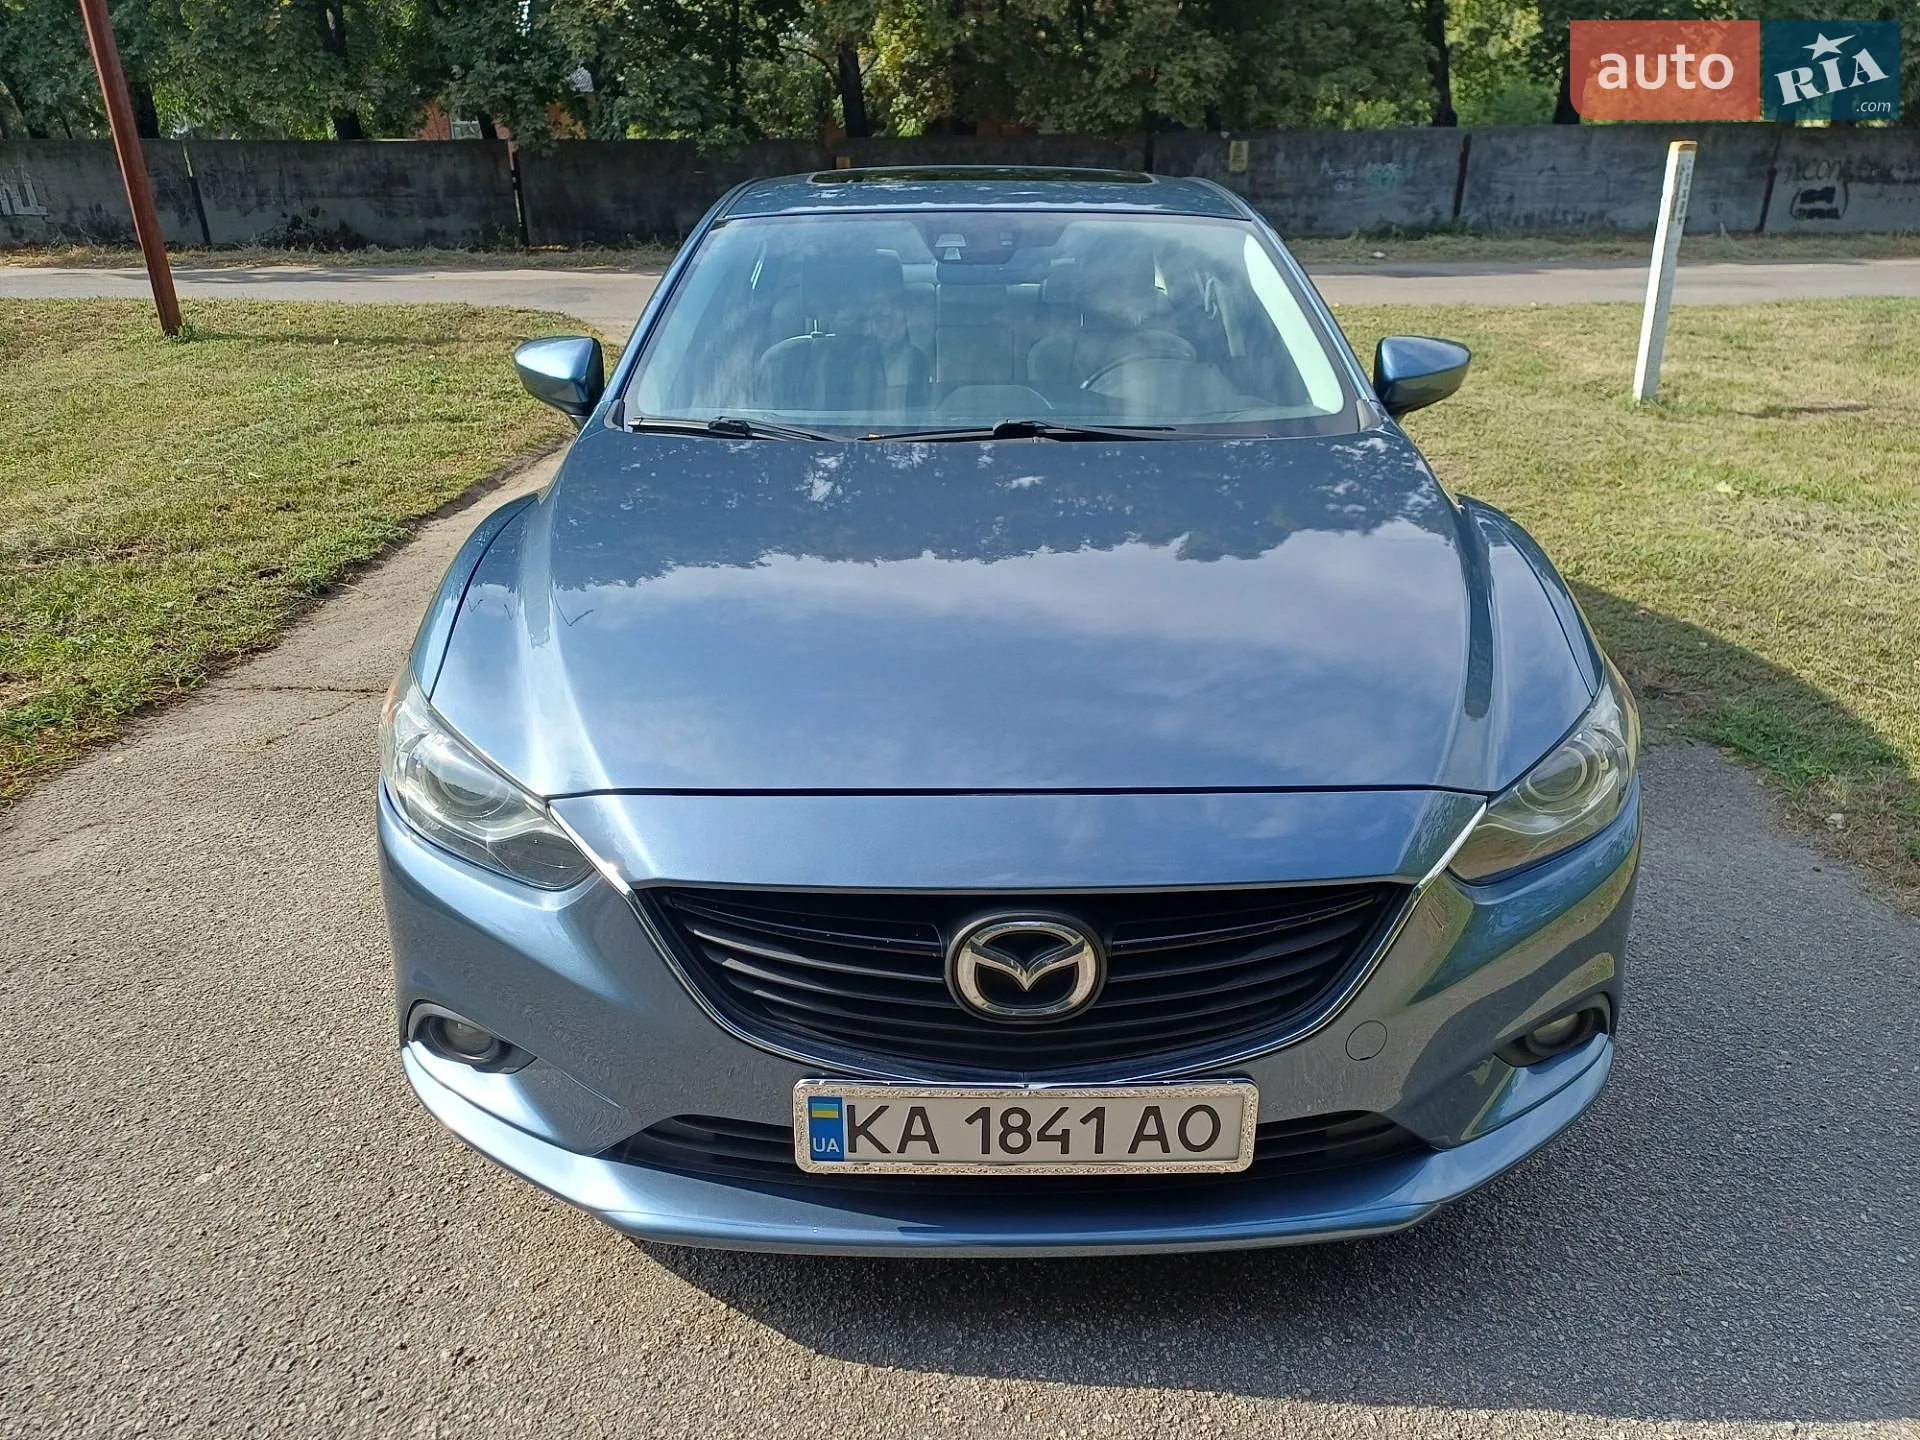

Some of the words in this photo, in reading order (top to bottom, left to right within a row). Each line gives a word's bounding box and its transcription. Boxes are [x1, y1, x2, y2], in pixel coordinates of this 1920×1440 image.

[812, 1138, 840, 1154] UA
[845, 1104, 940, 1155] KA
[964, 1106, 1106, 1155] 1841
[1127, 1104, 1222, 1154] AO
